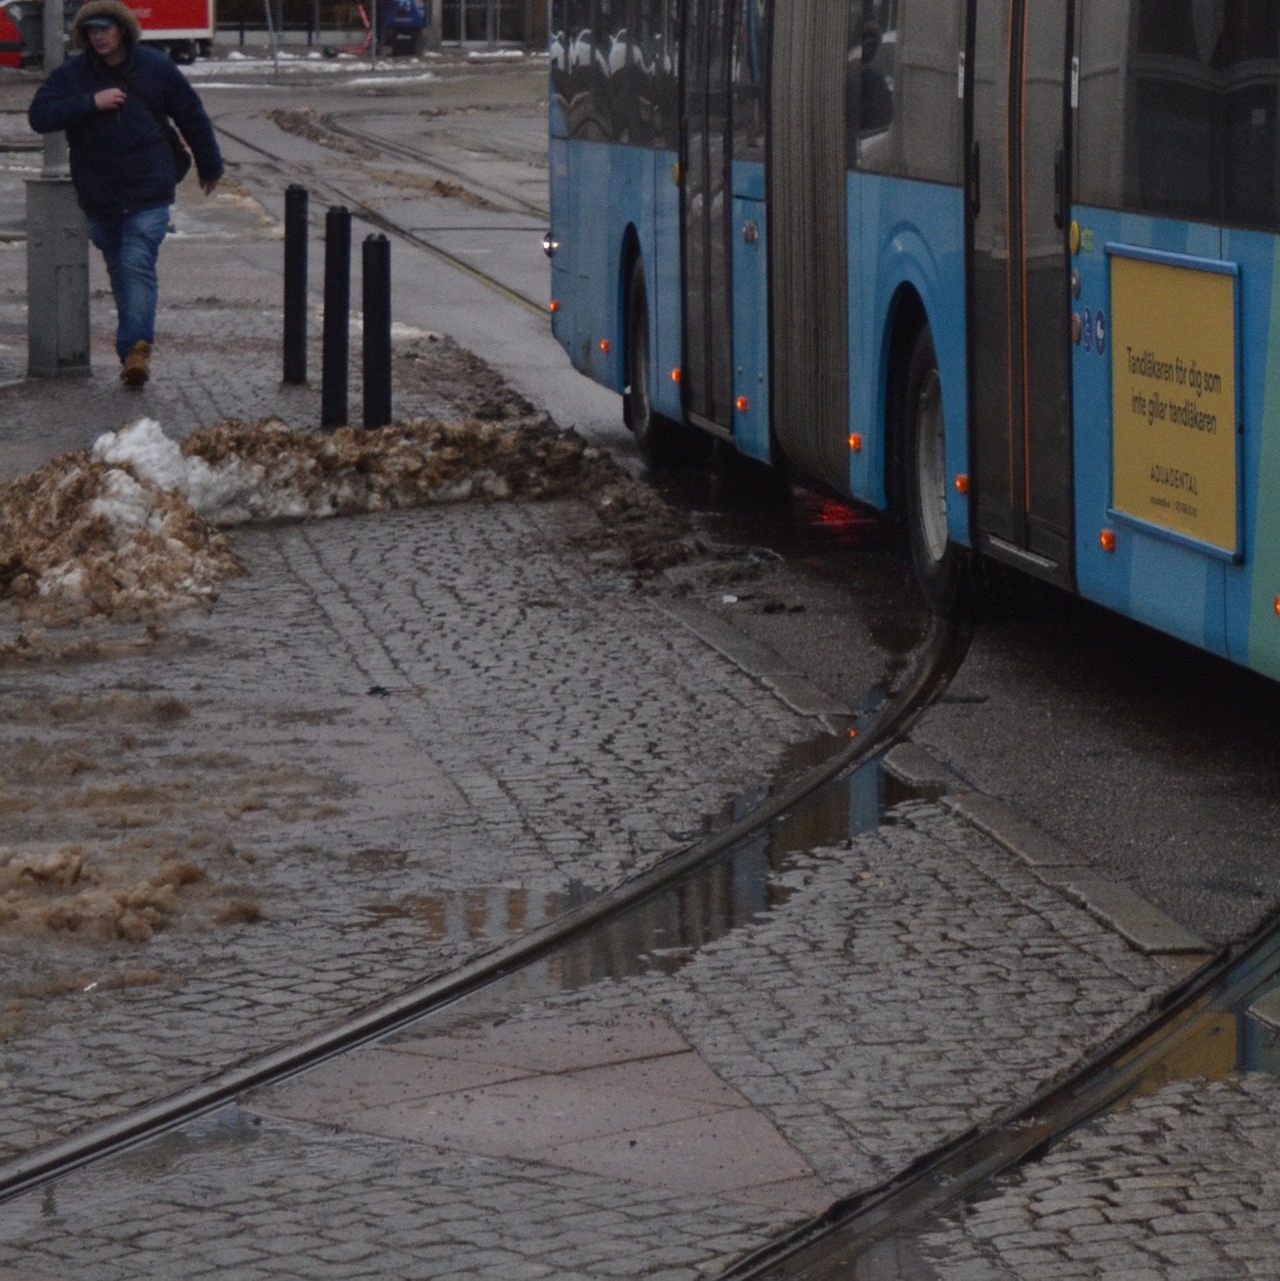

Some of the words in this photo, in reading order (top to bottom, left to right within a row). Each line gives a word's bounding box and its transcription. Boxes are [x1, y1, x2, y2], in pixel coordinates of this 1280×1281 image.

[1127, 346, 1175, 383] Tandläkaren
[1175, 356, 1188, 386] för
[1189, 360, 1203, 398] dig
[1204, 371, 1222, 395] som
[1131, 387, 1147, 417] inte
[1148, 391, 1168, 426] gillar
[1169, 399, 1217, 435] tandläkaren
